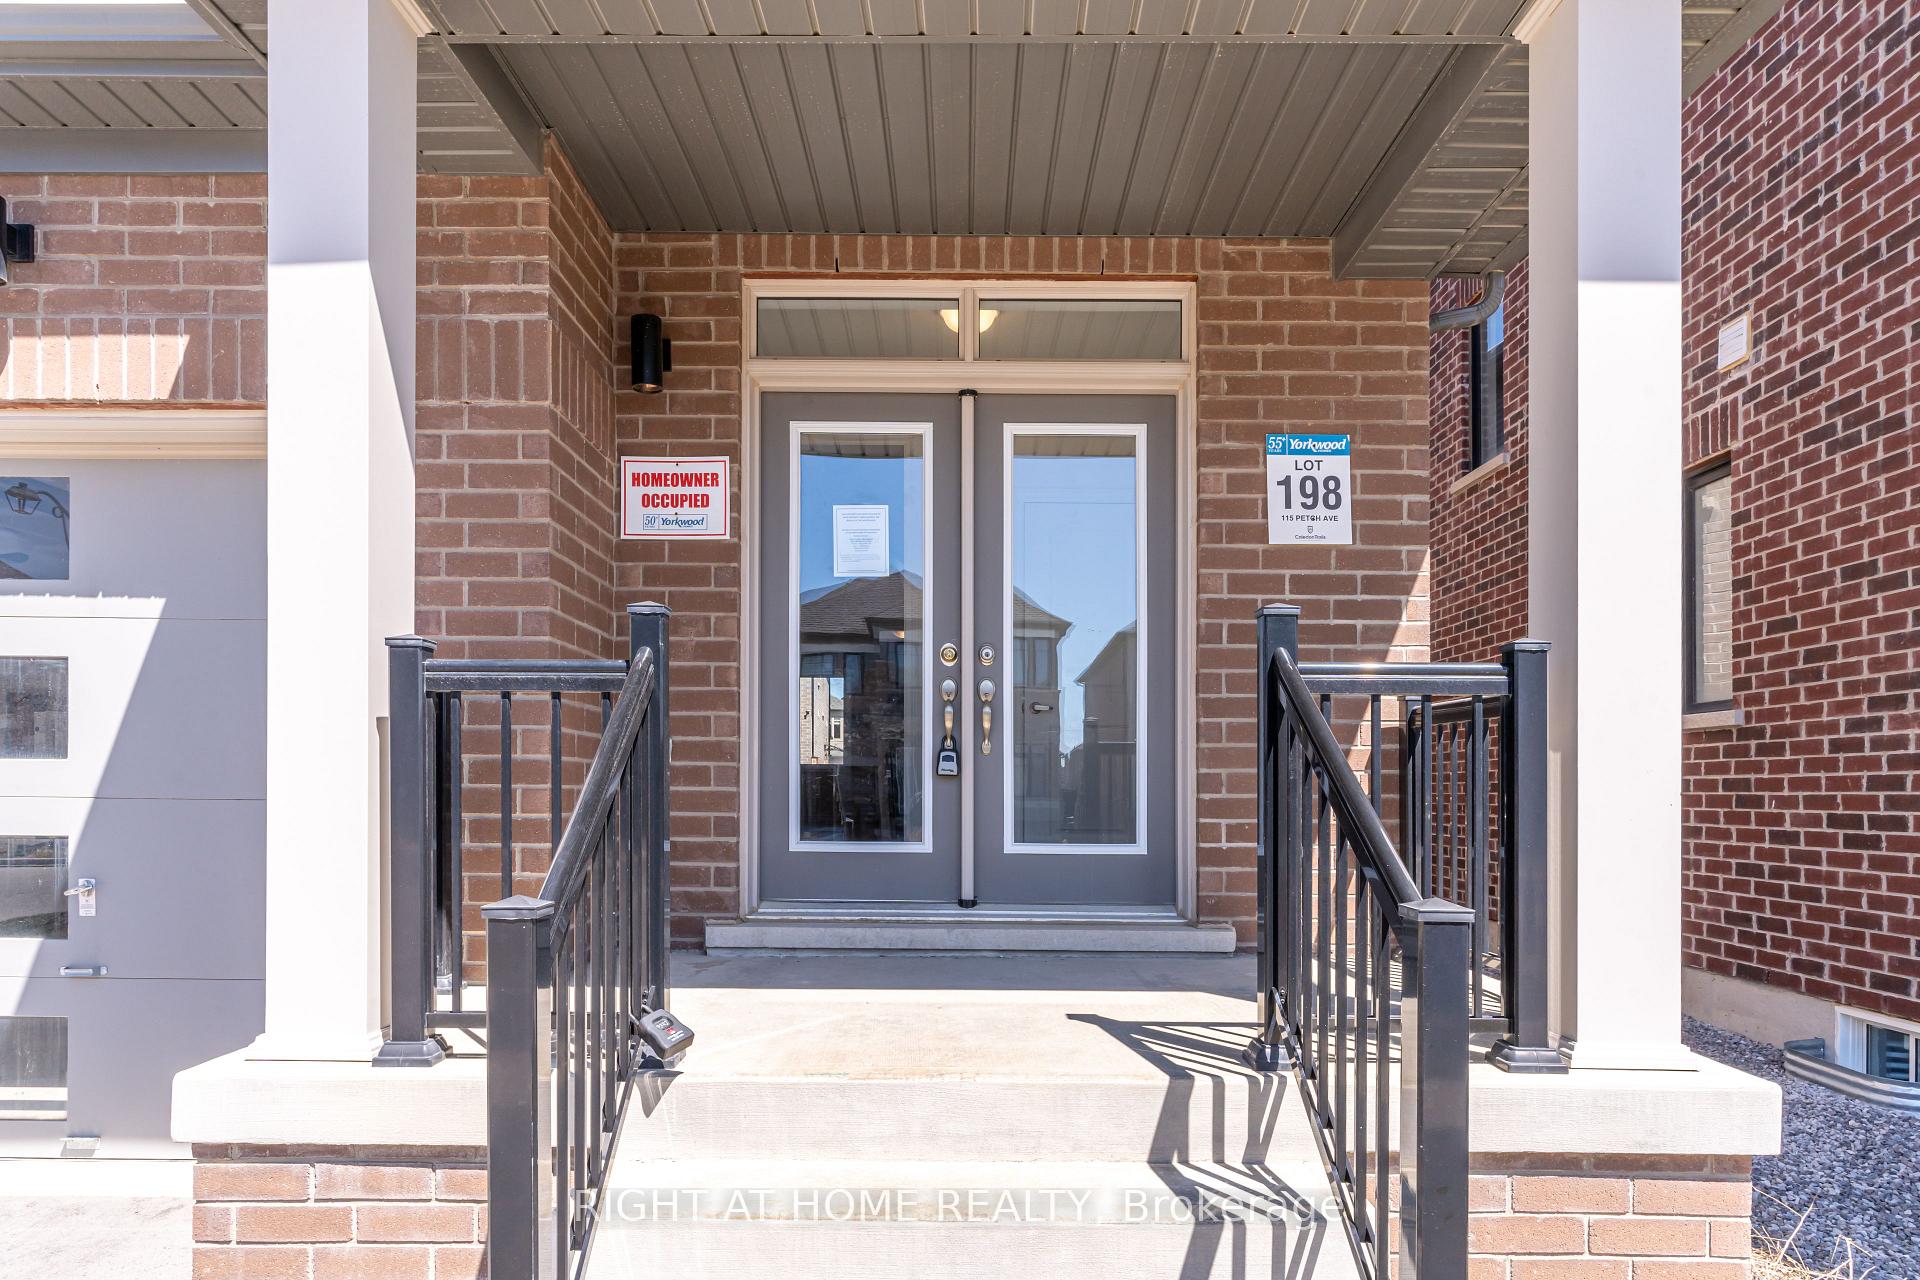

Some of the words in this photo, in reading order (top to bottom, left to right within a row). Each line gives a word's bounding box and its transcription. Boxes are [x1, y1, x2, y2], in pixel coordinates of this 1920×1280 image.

[1289, 438, 1347, 452] Yorkwood
[1295, 460, 1323, 471] LOT
[631, 472, 719, 487] HOMEOWNER
[1276, 475, 1342, 510] 198
[641, 493, 710, 508] OCCUPIED
[661, 516, 704, 527] Yorkwood
